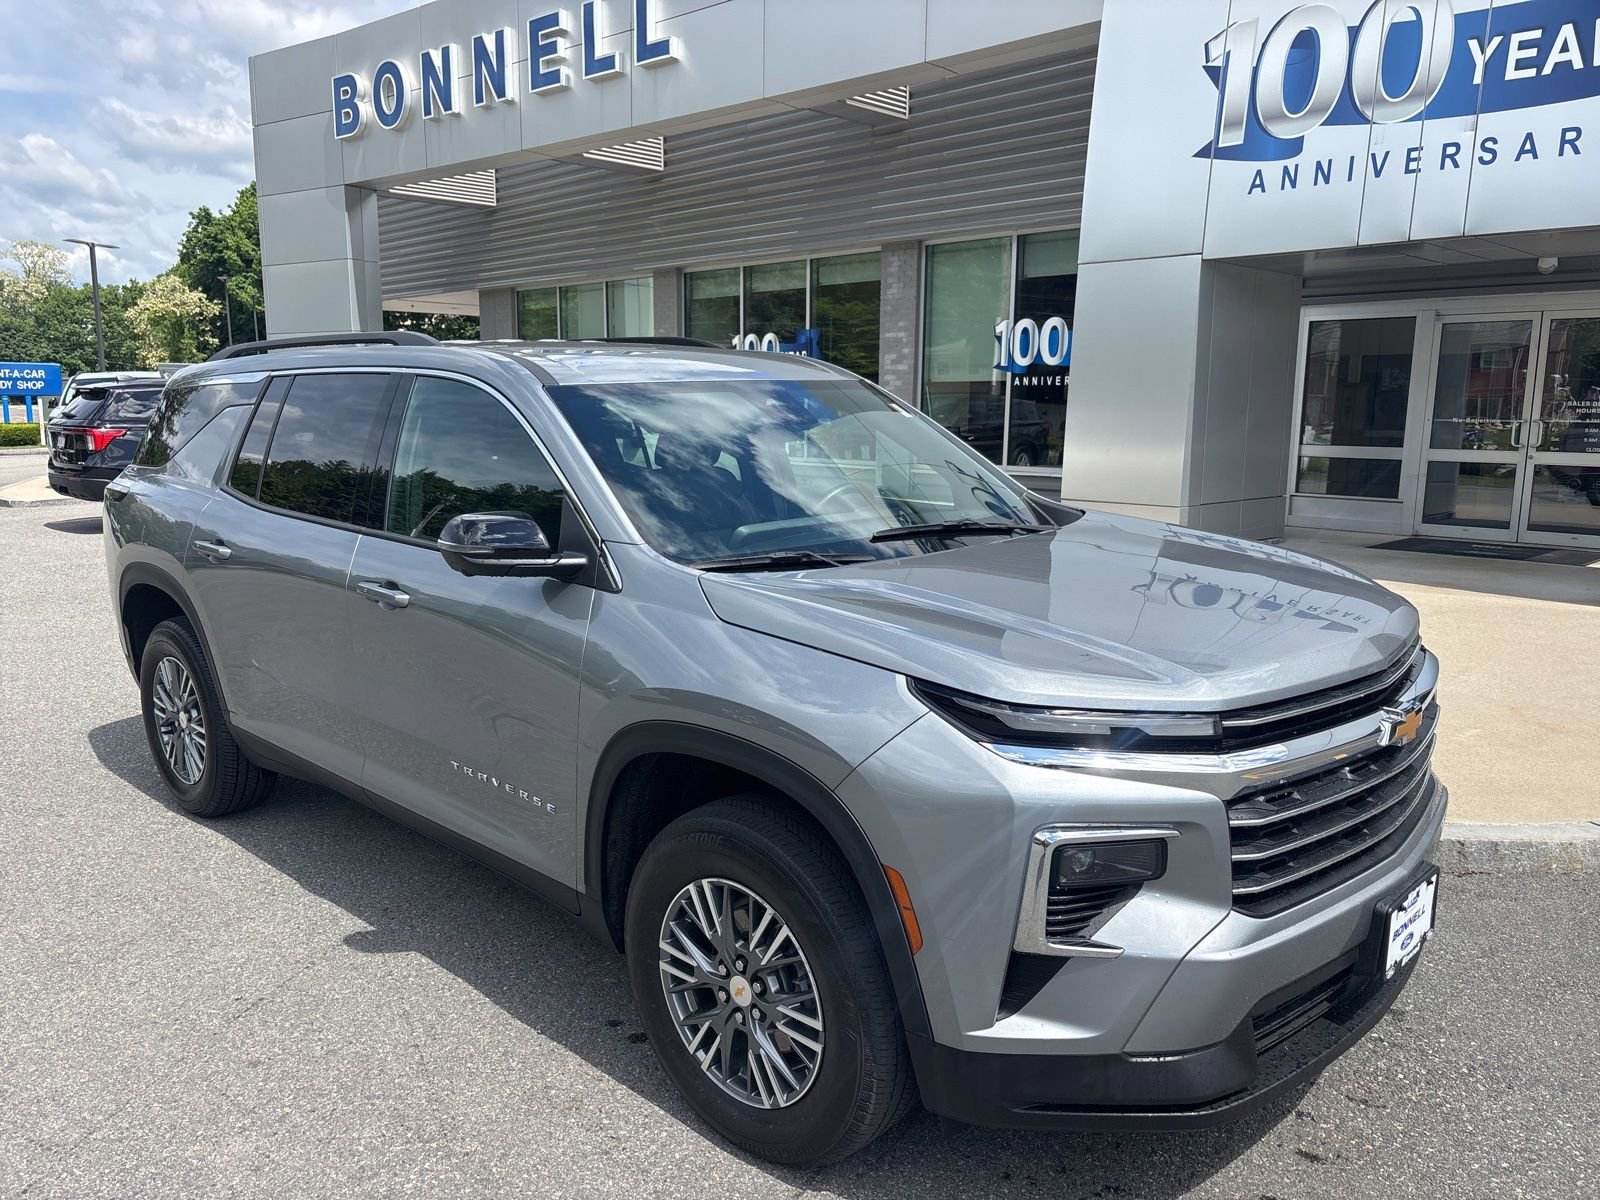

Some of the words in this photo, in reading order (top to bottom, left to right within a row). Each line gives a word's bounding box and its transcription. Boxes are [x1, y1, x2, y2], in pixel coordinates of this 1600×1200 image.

[332, 0, 680, 140] BONNELL
[1204, 0, 1455, 147] 100
[1248, 126, 1583, 195] ANNIVERSAR
[993, 316, 1069, 367] 100
[16, 380, 45, 390] SHOP
[1013, 376, 1070, 387] ANNIVER
[450, 760, 557, 815] TRAVERSE
[1391, 904, 1426, 944] BONNELL
